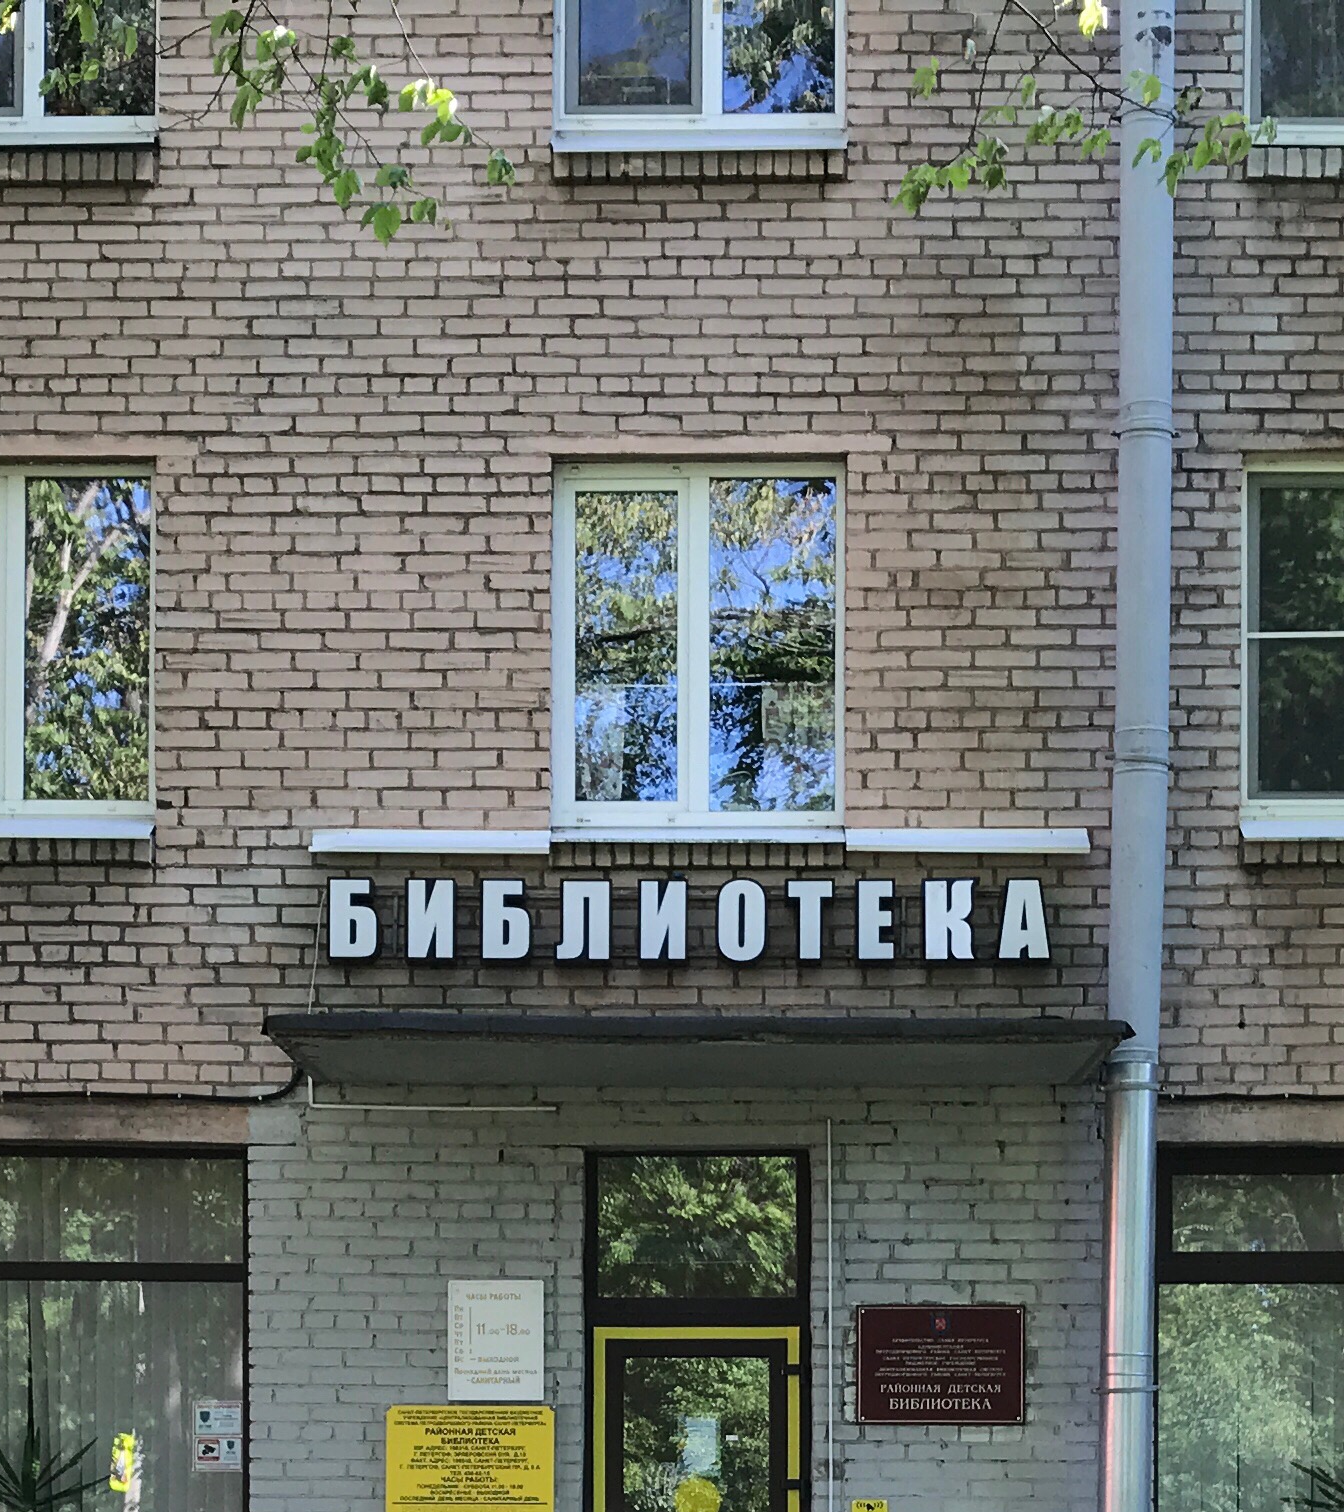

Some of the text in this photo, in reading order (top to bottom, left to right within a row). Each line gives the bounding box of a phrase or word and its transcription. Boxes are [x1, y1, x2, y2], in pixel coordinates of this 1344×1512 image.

[327, 877, 1052, 963] БИБЛИОТЕКА
[881, 1383, 1001, 1394] РАЙОННАЯ ДЕТСКАЯ
[890, 1398, 992, 1410] БИБЛИОТЕКА
[424, 1427, 516, 1437] РАЙОННАЯ ДЕТСКАЯ
